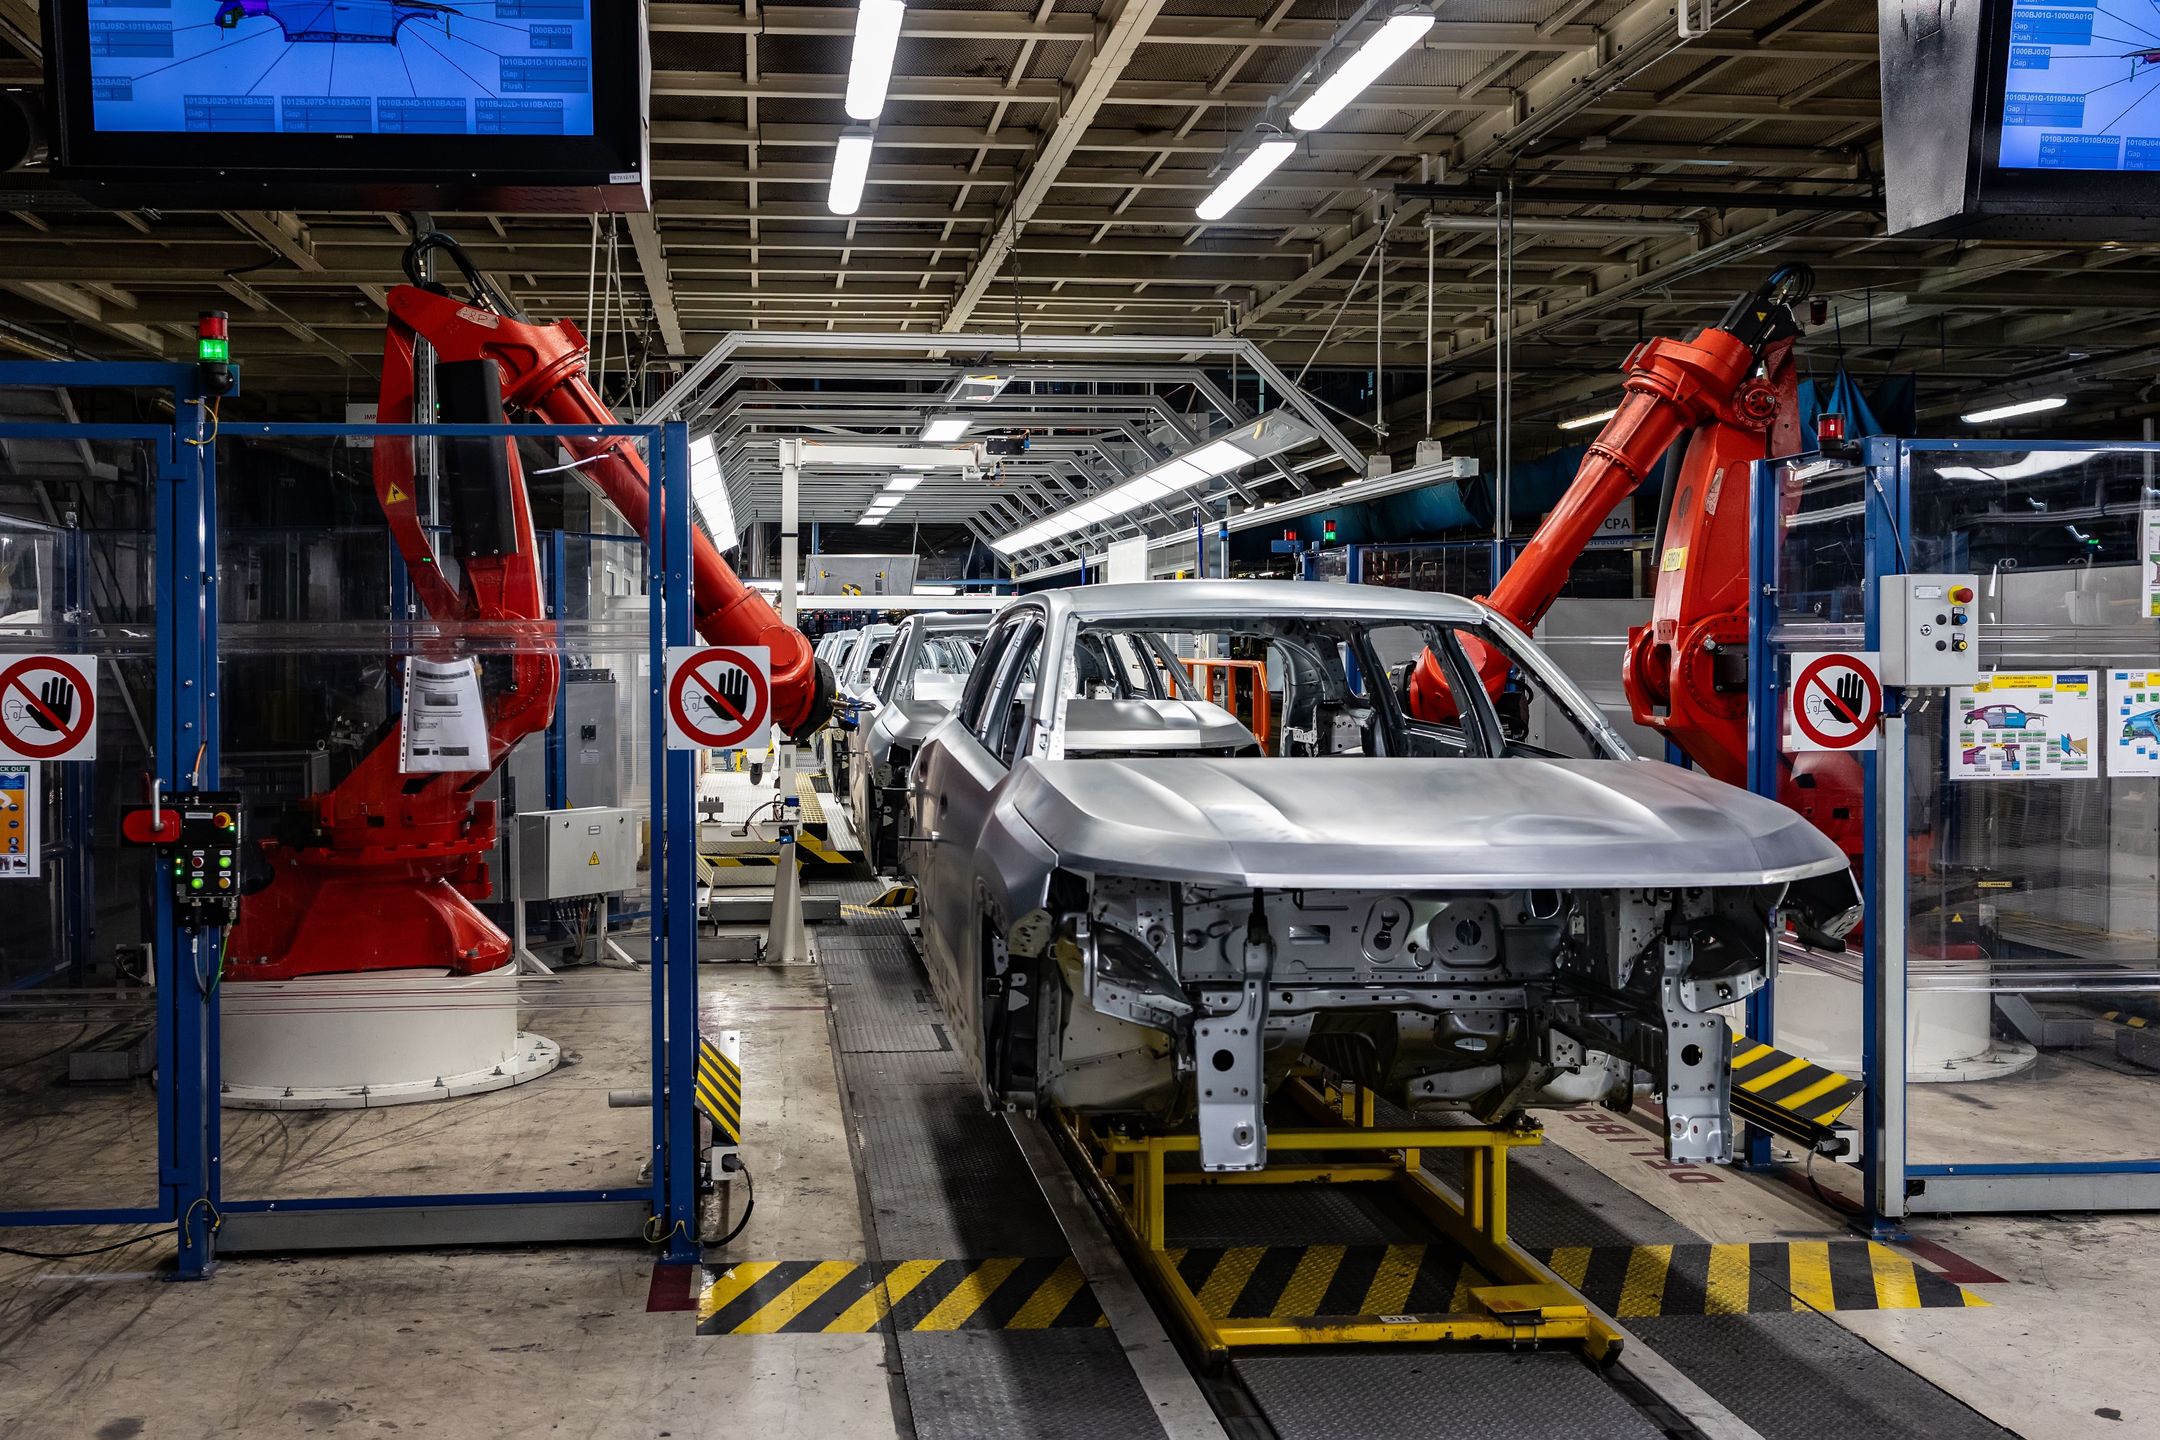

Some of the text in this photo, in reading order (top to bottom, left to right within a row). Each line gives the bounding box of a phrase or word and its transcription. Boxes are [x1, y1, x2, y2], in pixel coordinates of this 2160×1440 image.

[2014, 11, 2093, 20] 1000BJ01G-1000BA01G
[2012, 48, 2050, 56] 1000BJ03G
[501, 58, 587, 67] 1010BJ01D-1010BA01D
[503, 82, 523, 90] Flush
[2006, 94, 2085, 103] 1010BJ01G-1010BA01G
[2005, 116, 2023, 124] Flush
[2041, 135, 2120, 145] 1010BJ02G-1010BA02G
[2127, 138, 2160, 147] 1010BJ04
[2041, 147, 2056, 155] Gap
[2127, 150, 2141, 158] Gap
[1604, 518, 1630, 530] CPA
